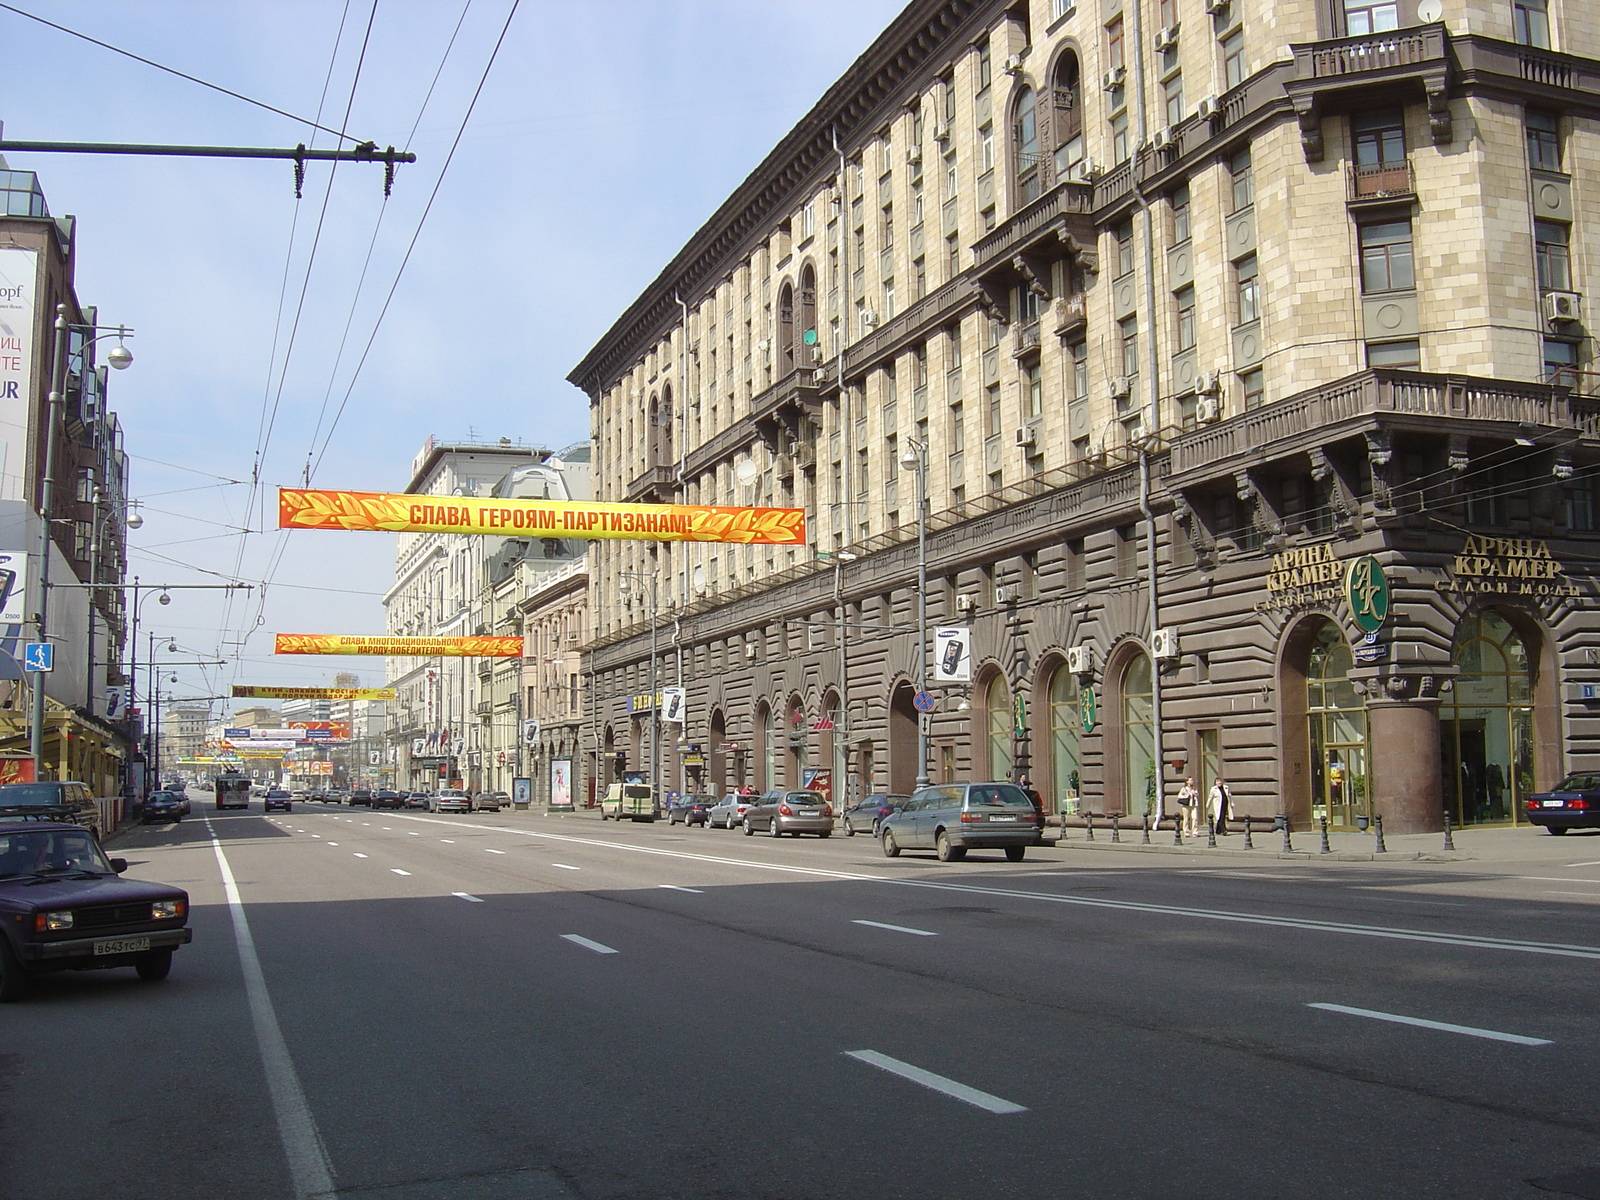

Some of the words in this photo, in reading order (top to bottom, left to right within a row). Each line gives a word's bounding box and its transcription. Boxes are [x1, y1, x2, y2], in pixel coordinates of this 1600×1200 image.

[0, 356, 21, 371] ТЕ
[409, 505, 471, 526] СЛАВА
[479, 508, 692, 533] ГЕРОЯМ-ПАРТИЗАНАМ!
[1270, 542, 1337, 572] АРИНА
[1460, 536, 1552, 559] АРИНА
[1266, 560, 1344, 592] КРАМЕР
[1454, 556, 1561, 579] КРАМЕР
[1434, 581, 1508, 594] САЛОН
[1519, 583, 1580, 596] МОДЫ
[340, 637, 365, 645] СЛАВА
[368, 637, 463, 646] МНОГОНАЦИОНАЛЬНОМУ
[357, 646, 446, 655] НАРОДУ-ПОБЕДИТЕЛЮ!
